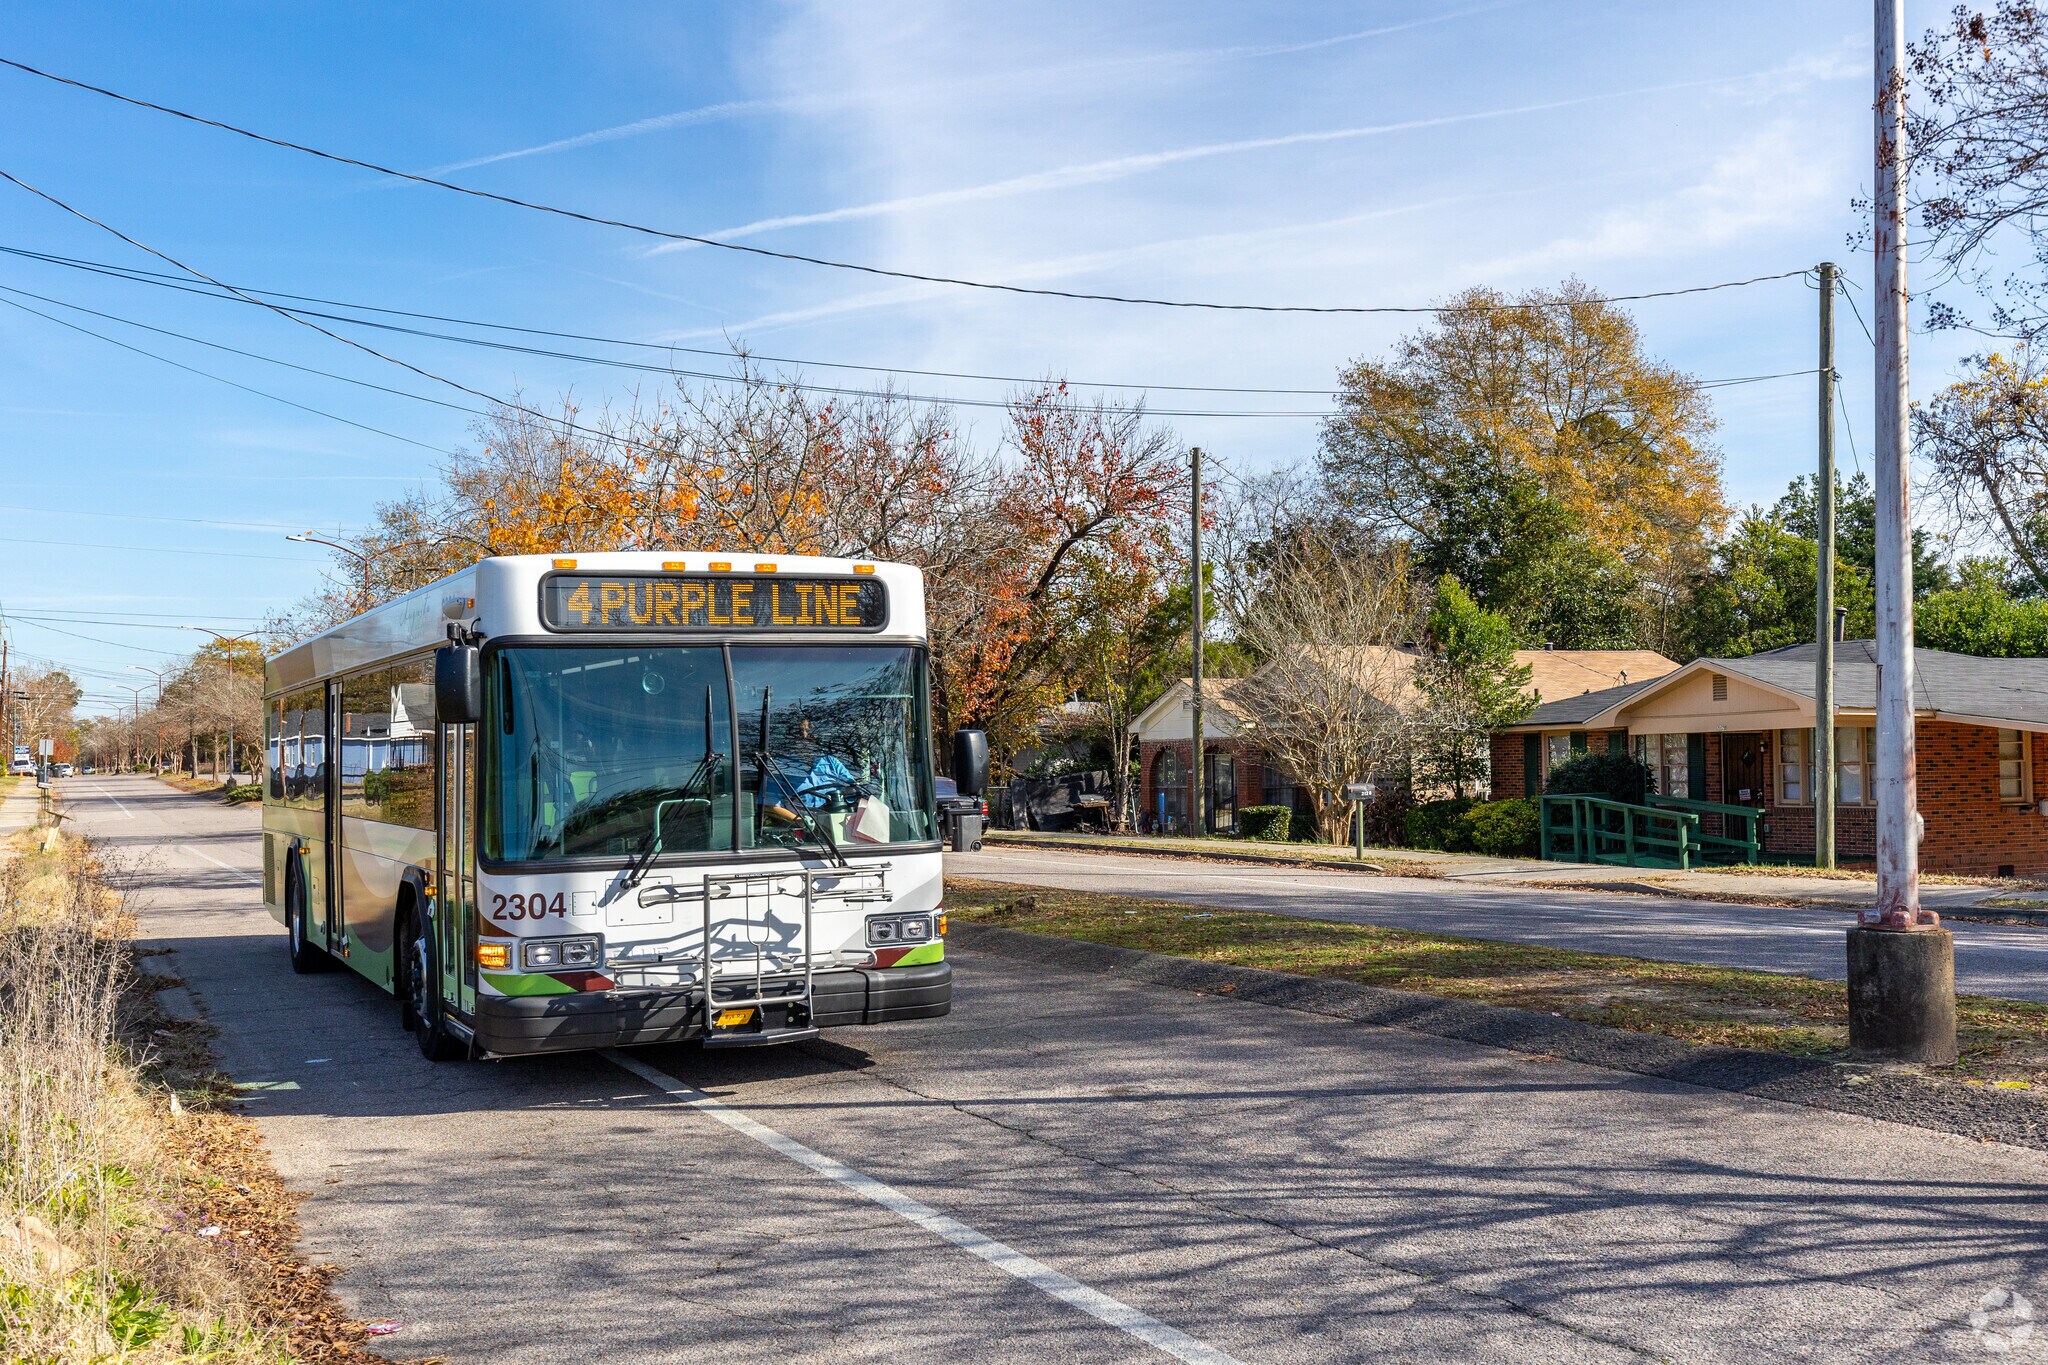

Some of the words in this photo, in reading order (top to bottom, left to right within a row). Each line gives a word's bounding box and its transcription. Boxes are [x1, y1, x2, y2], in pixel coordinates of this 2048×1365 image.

[601, 582, 755, 625] PURPLE
[772, 583, 861, 625] LINE
[492, 892, 567, 921] 2304
